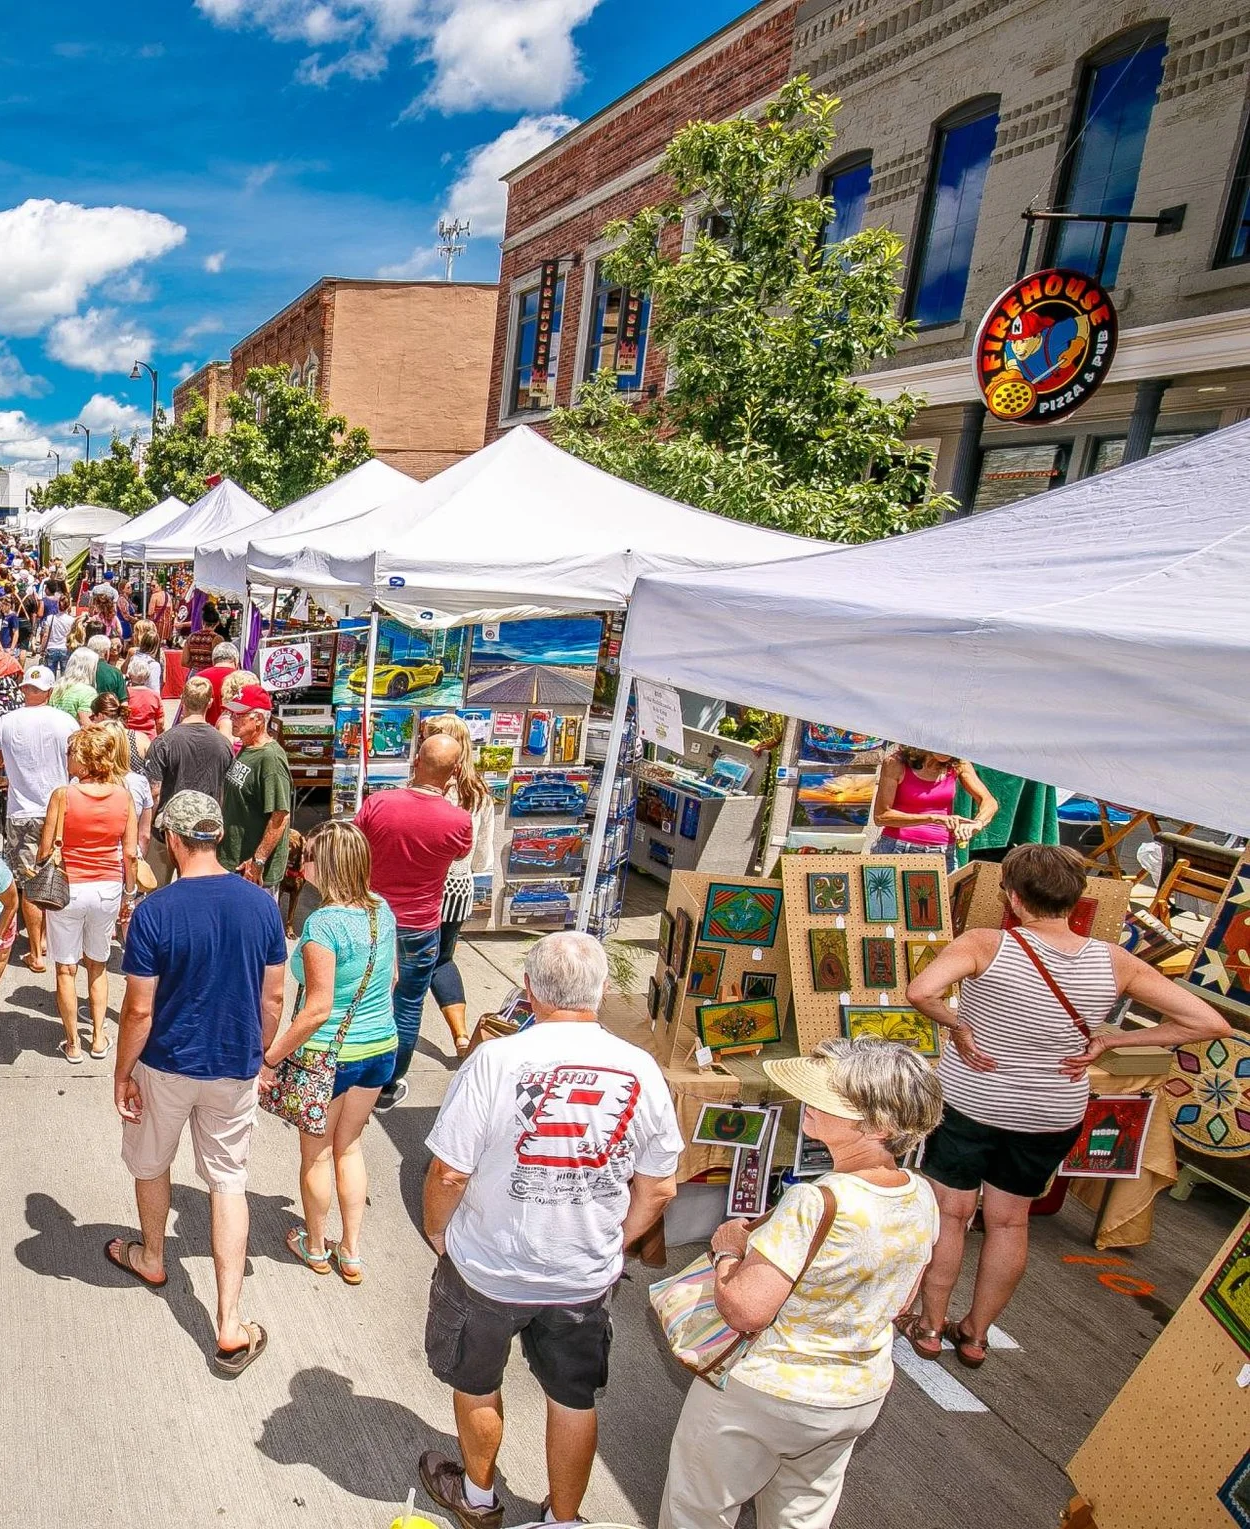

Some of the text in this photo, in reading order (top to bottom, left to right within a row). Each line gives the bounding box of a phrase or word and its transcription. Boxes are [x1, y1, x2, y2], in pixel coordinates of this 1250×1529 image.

[537, 264, 553, 365] FIREHOUSE
[983, 274, 1110, 372] FIREHOUSE
[1039, 329, 1108, 414] PIZZA & PUB
[519, 1071, 599, 1085] BREYTON
